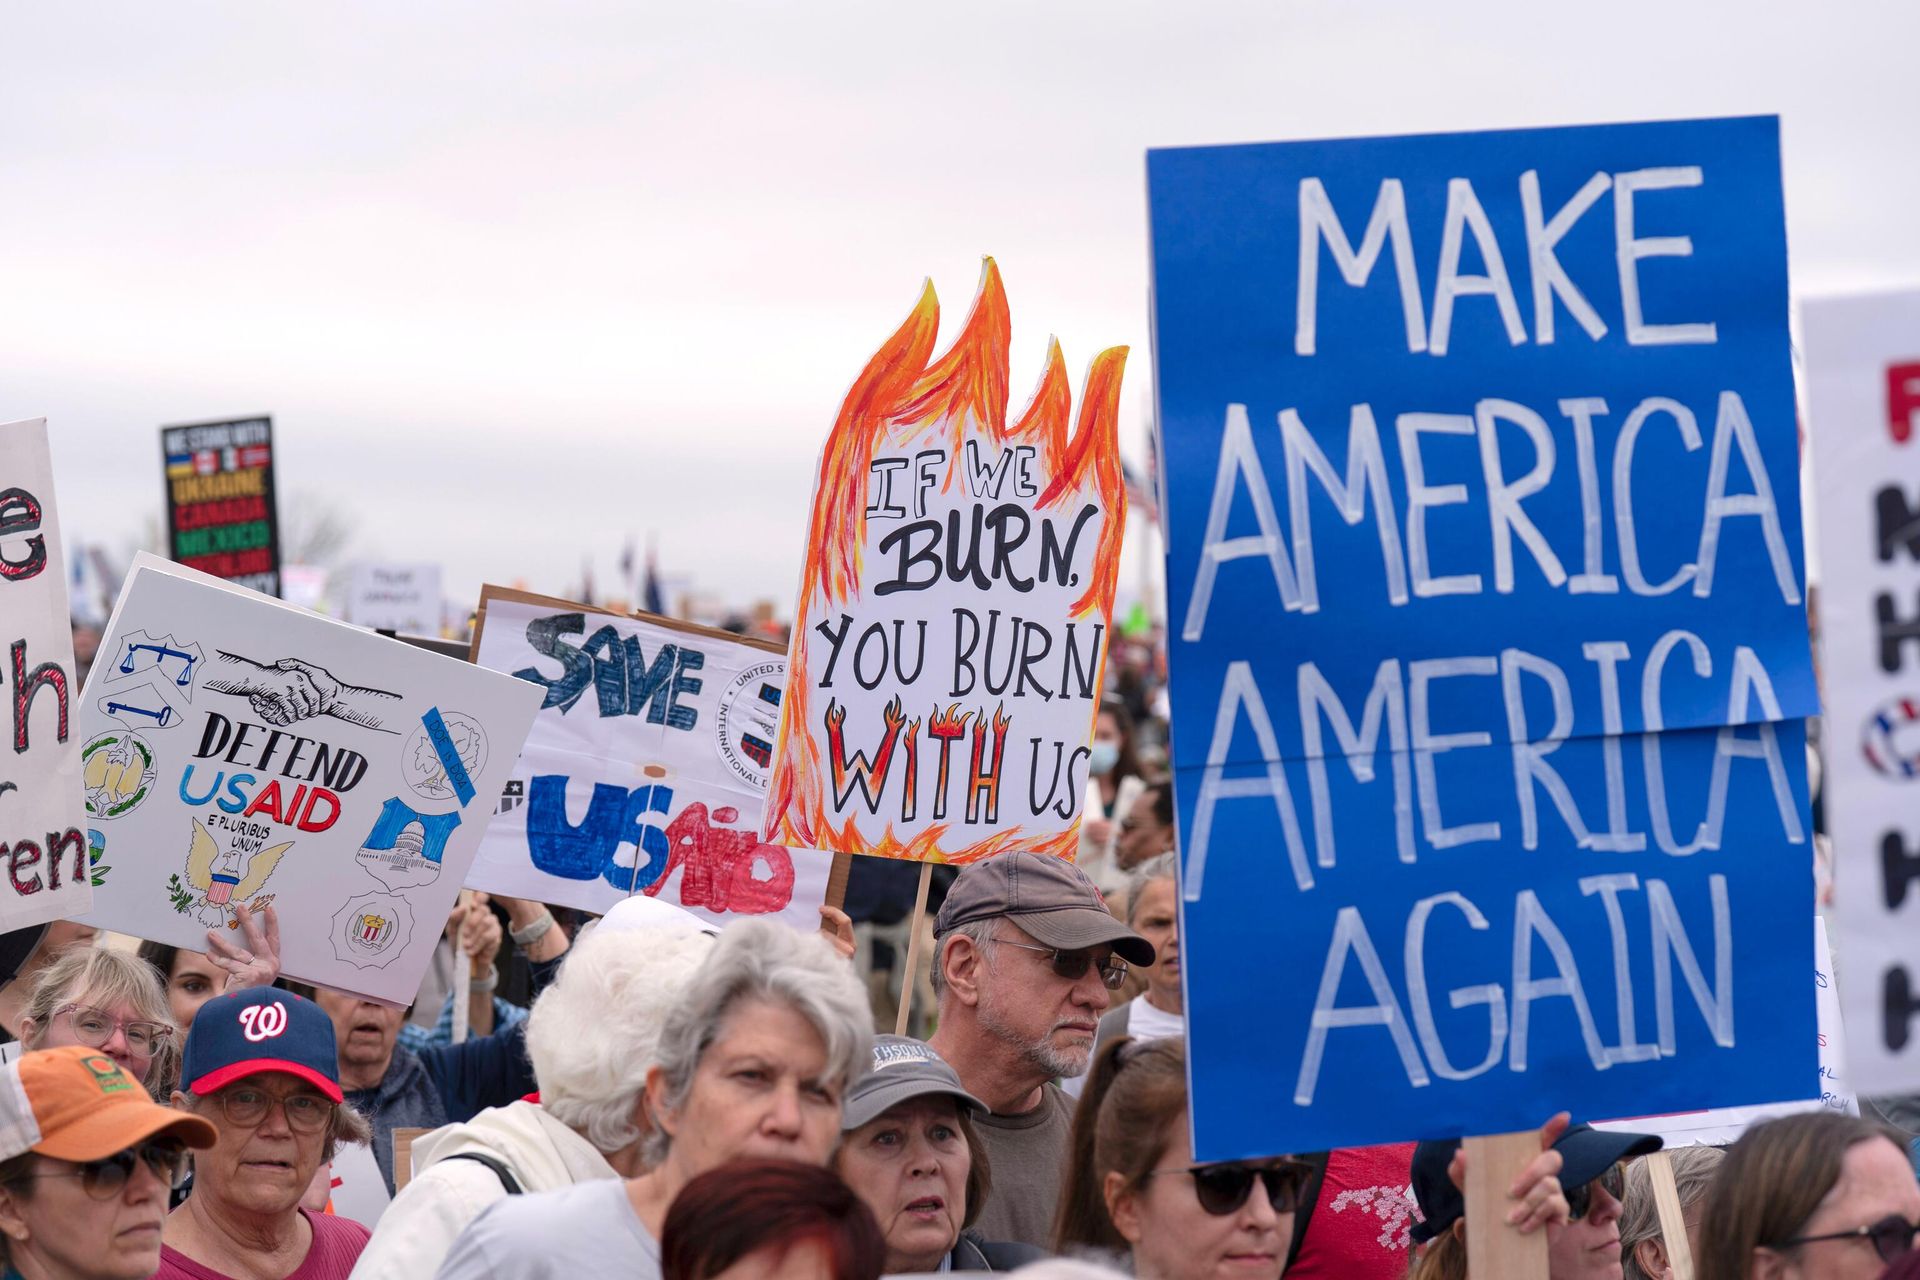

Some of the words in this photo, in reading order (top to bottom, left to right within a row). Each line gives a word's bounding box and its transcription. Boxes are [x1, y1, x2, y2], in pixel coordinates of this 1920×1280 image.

[1295, 166, 1717, 356] MAKE
[866, 450, 945, 519] IF
[966, 439, 1037, 500] WE
[1182, 391, 1802, 641] AMERICA
[874, 503, 1098, 596] BURN,
[511, 613, 705, 731] SAVE
[736, 664, 774, 687] UNITED
[815, 613, 928, 690] YOU
[949, 608, 1104, 702] BURN
[192, 711, 368, 793] DEFEND
[429, 720, 449, 746] DOE
[450, 764, 467, 790] DOA
[718, 703, 759, 786] INTERNATIONAL
[825, 694, 1012, 824] WITH
[1029, 737, 1092, 820] US
[1183, 629, 1805, 902] AMERICA
[179, 764, 342, 833] USAID
[207, 814, 217, 826] E
[218, 816, 271, 840] PLURIBUS
[231, 836, 263, 855] UNUM
[238, 1001, 289, 1041] W
[1294, 874, 1735, 1106] AGAIN
